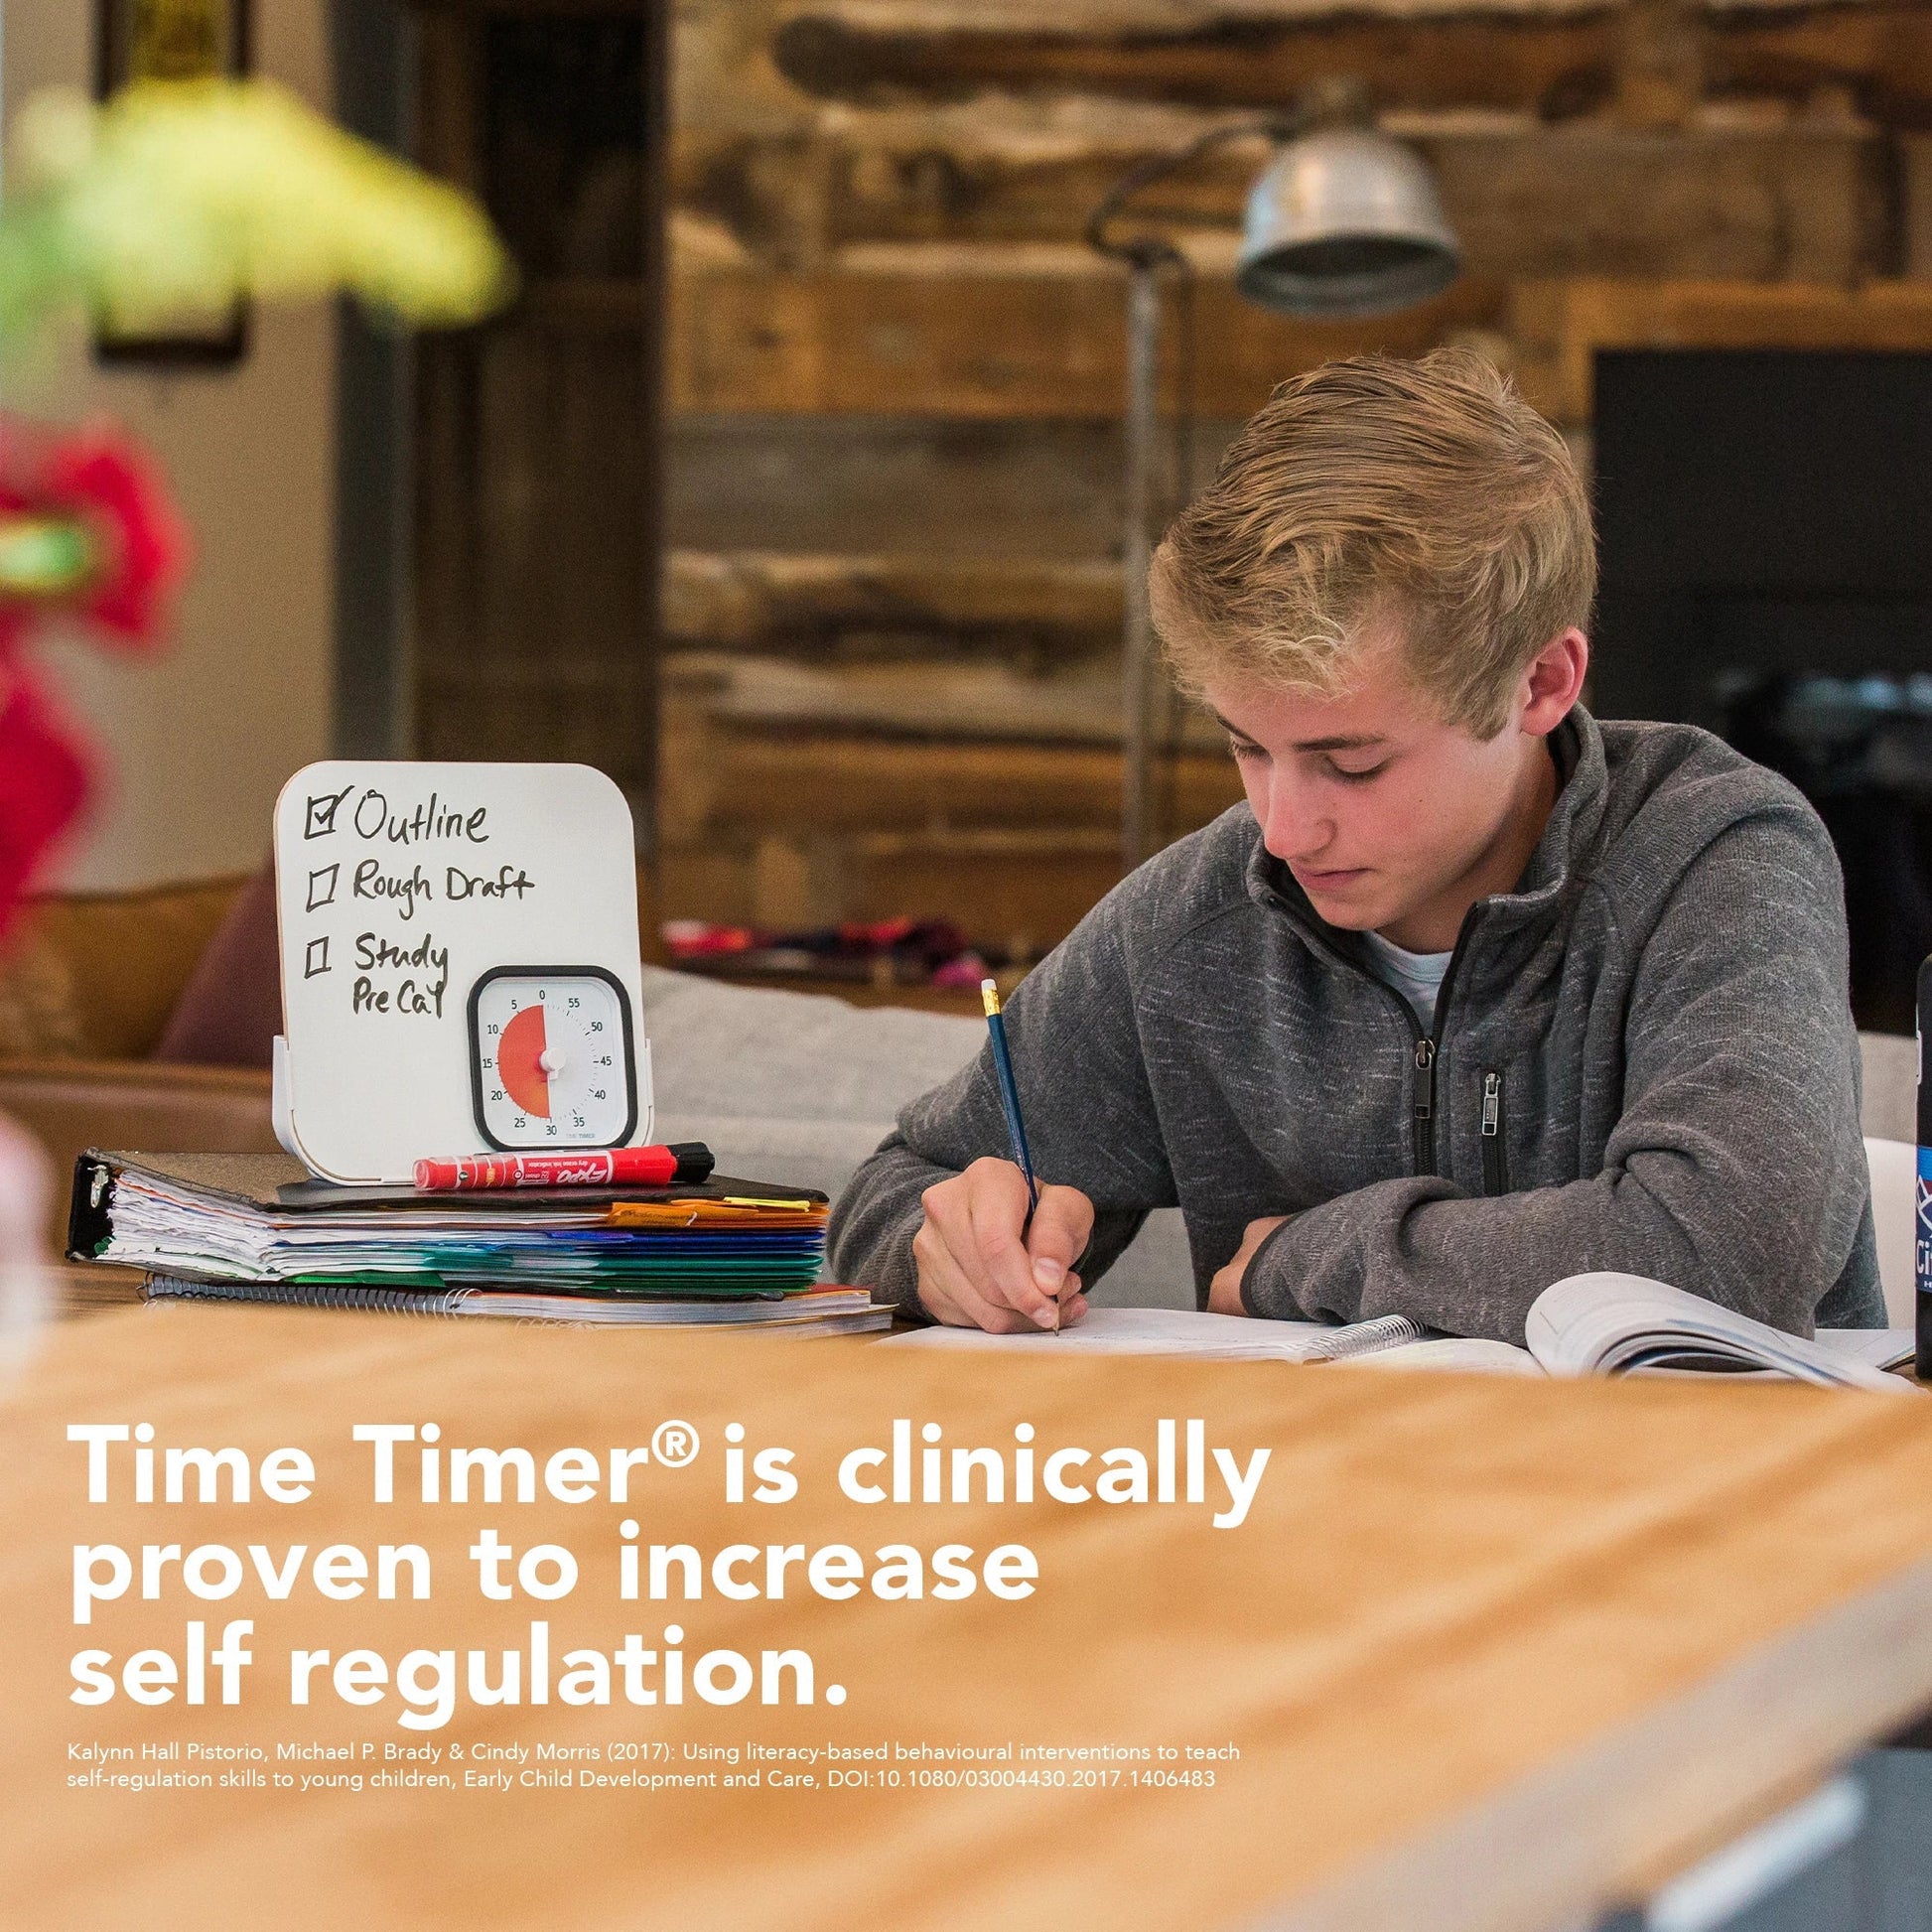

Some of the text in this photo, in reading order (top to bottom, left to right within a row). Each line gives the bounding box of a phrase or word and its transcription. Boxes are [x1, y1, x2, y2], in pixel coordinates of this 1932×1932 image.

[354, 789, 489, 845] Outline
[353, 859, 535, 920] Rough Draft
[354, 932, 449, 989] Study
[539, 989, 546, 1001] 0
[511, 1000, 517, 1010] 5
[568, 998, 581, 1009] 55
[487, 1025, 498, 1035] 10
[591, 1022, 603, 1032] 50
[483, 1058, 492, 1068] 15
[600, 1056, 612, 1066] 45
[491, 1091, 502, 1101] 20
[594, 1090, 606, 1100] 40
[514, 1118, 526, 1128] 25
[573, 1117, 585, 1128] 35
[546, 1125, 557, 1136] 30
[556, 1163, 608, 1183] EXPO
